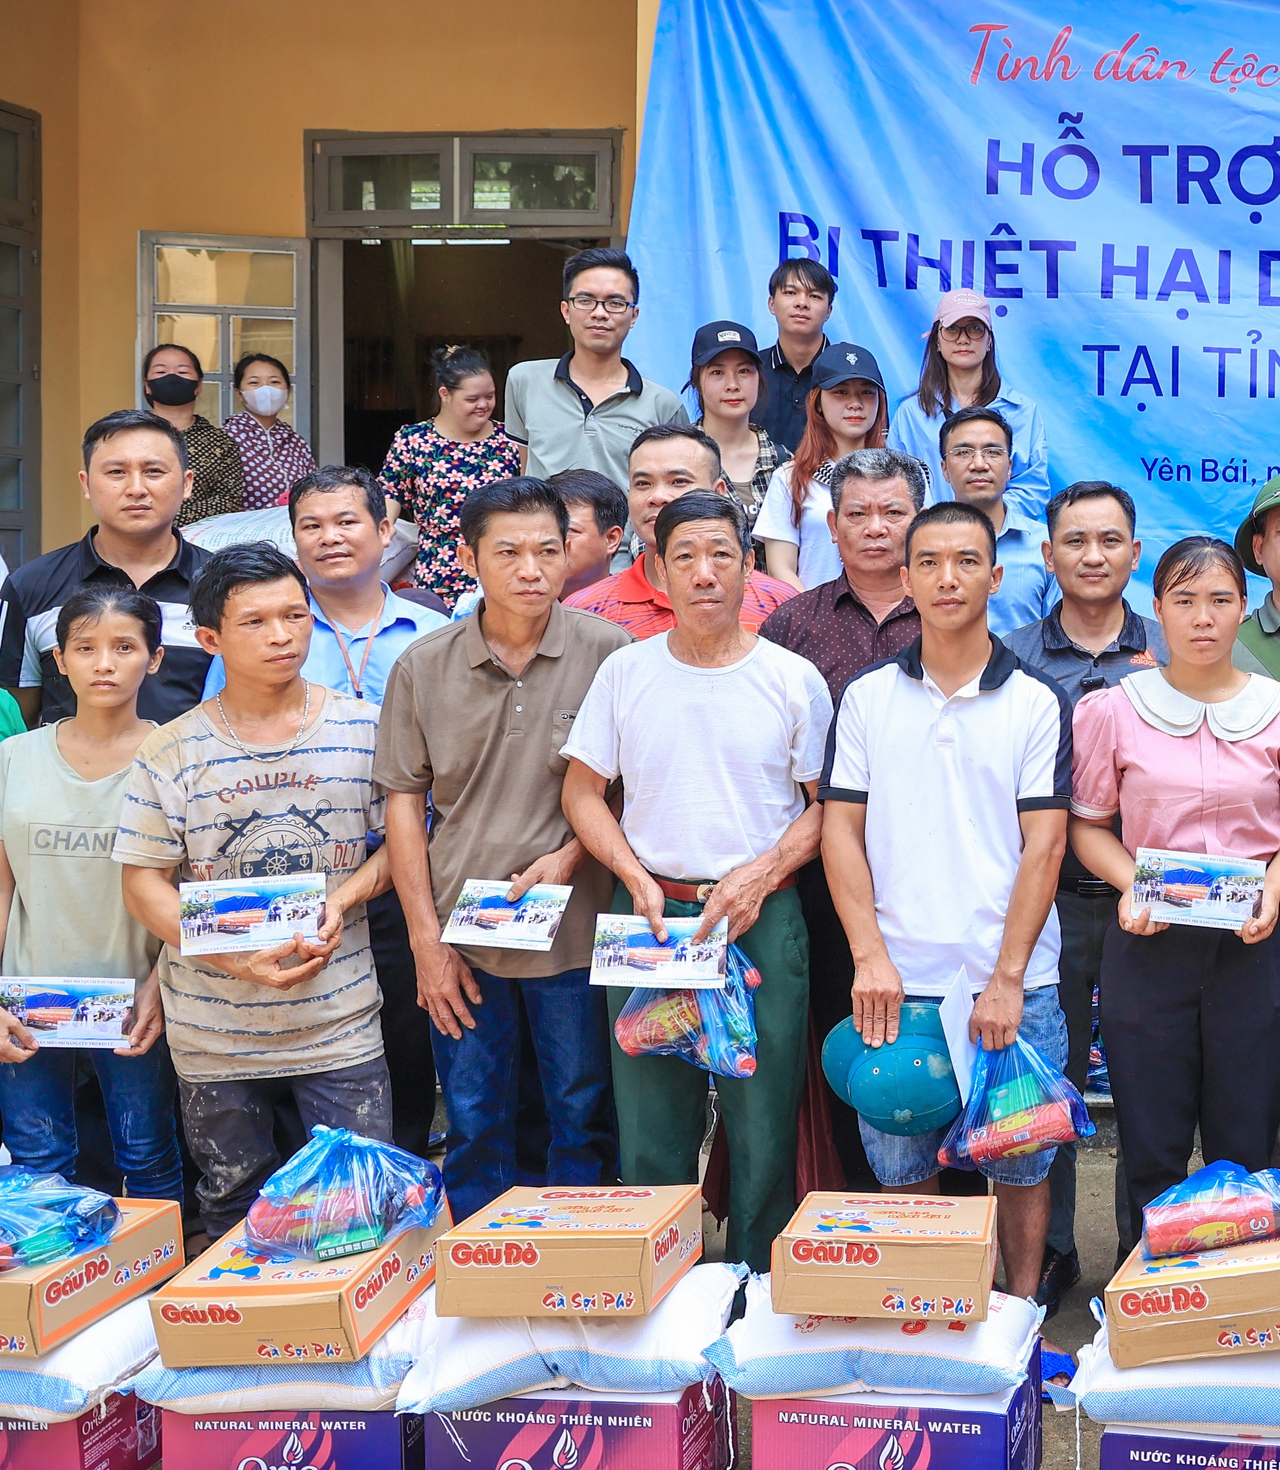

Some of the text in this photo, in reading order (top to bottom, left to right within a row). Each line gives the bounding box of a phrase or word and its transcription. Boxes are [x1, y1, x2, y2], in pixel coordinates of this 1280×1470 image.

[967, 23, 1082, 86] Tình
[1093, 32, 1195, 84] dân
[985, 112, 1100, 199] HỖ
[861, 223, 1076, 317] THIỆT
[1101, 244, 1232, 320] HẠI
[1082, 344, 1180, 412] TẠI
[1140, 457, 1191, 482] Yên
[1200, 457, 1258, 486] Bái,
[1130, 656, 1159, 667] adidas
[218, 772, 322, 805] COUPLE
[34, 829, 116, 852] CHAN
[334, 843, 358, 869] DLT
[542, 1292, 566, 1310] Gà
[881, 1294, 905, 1312] Gà
[1217, 1330, 1242, 1348] Gà
[257, 1343, 281, 1359] Gà
[194, 1420, 366, 1431] NATURAL MINERAL WATER
[452, 1409, 653, 1428] NƯỚC KHOÁNG THIÊN NHIÊN
[778, 1411, 982, 1435] NATURAL MINERAL WATER
[1129, 1449, 1172, 1464] NƯỚC
[1176, 1453, 1239, 1469] KHOÁNG
